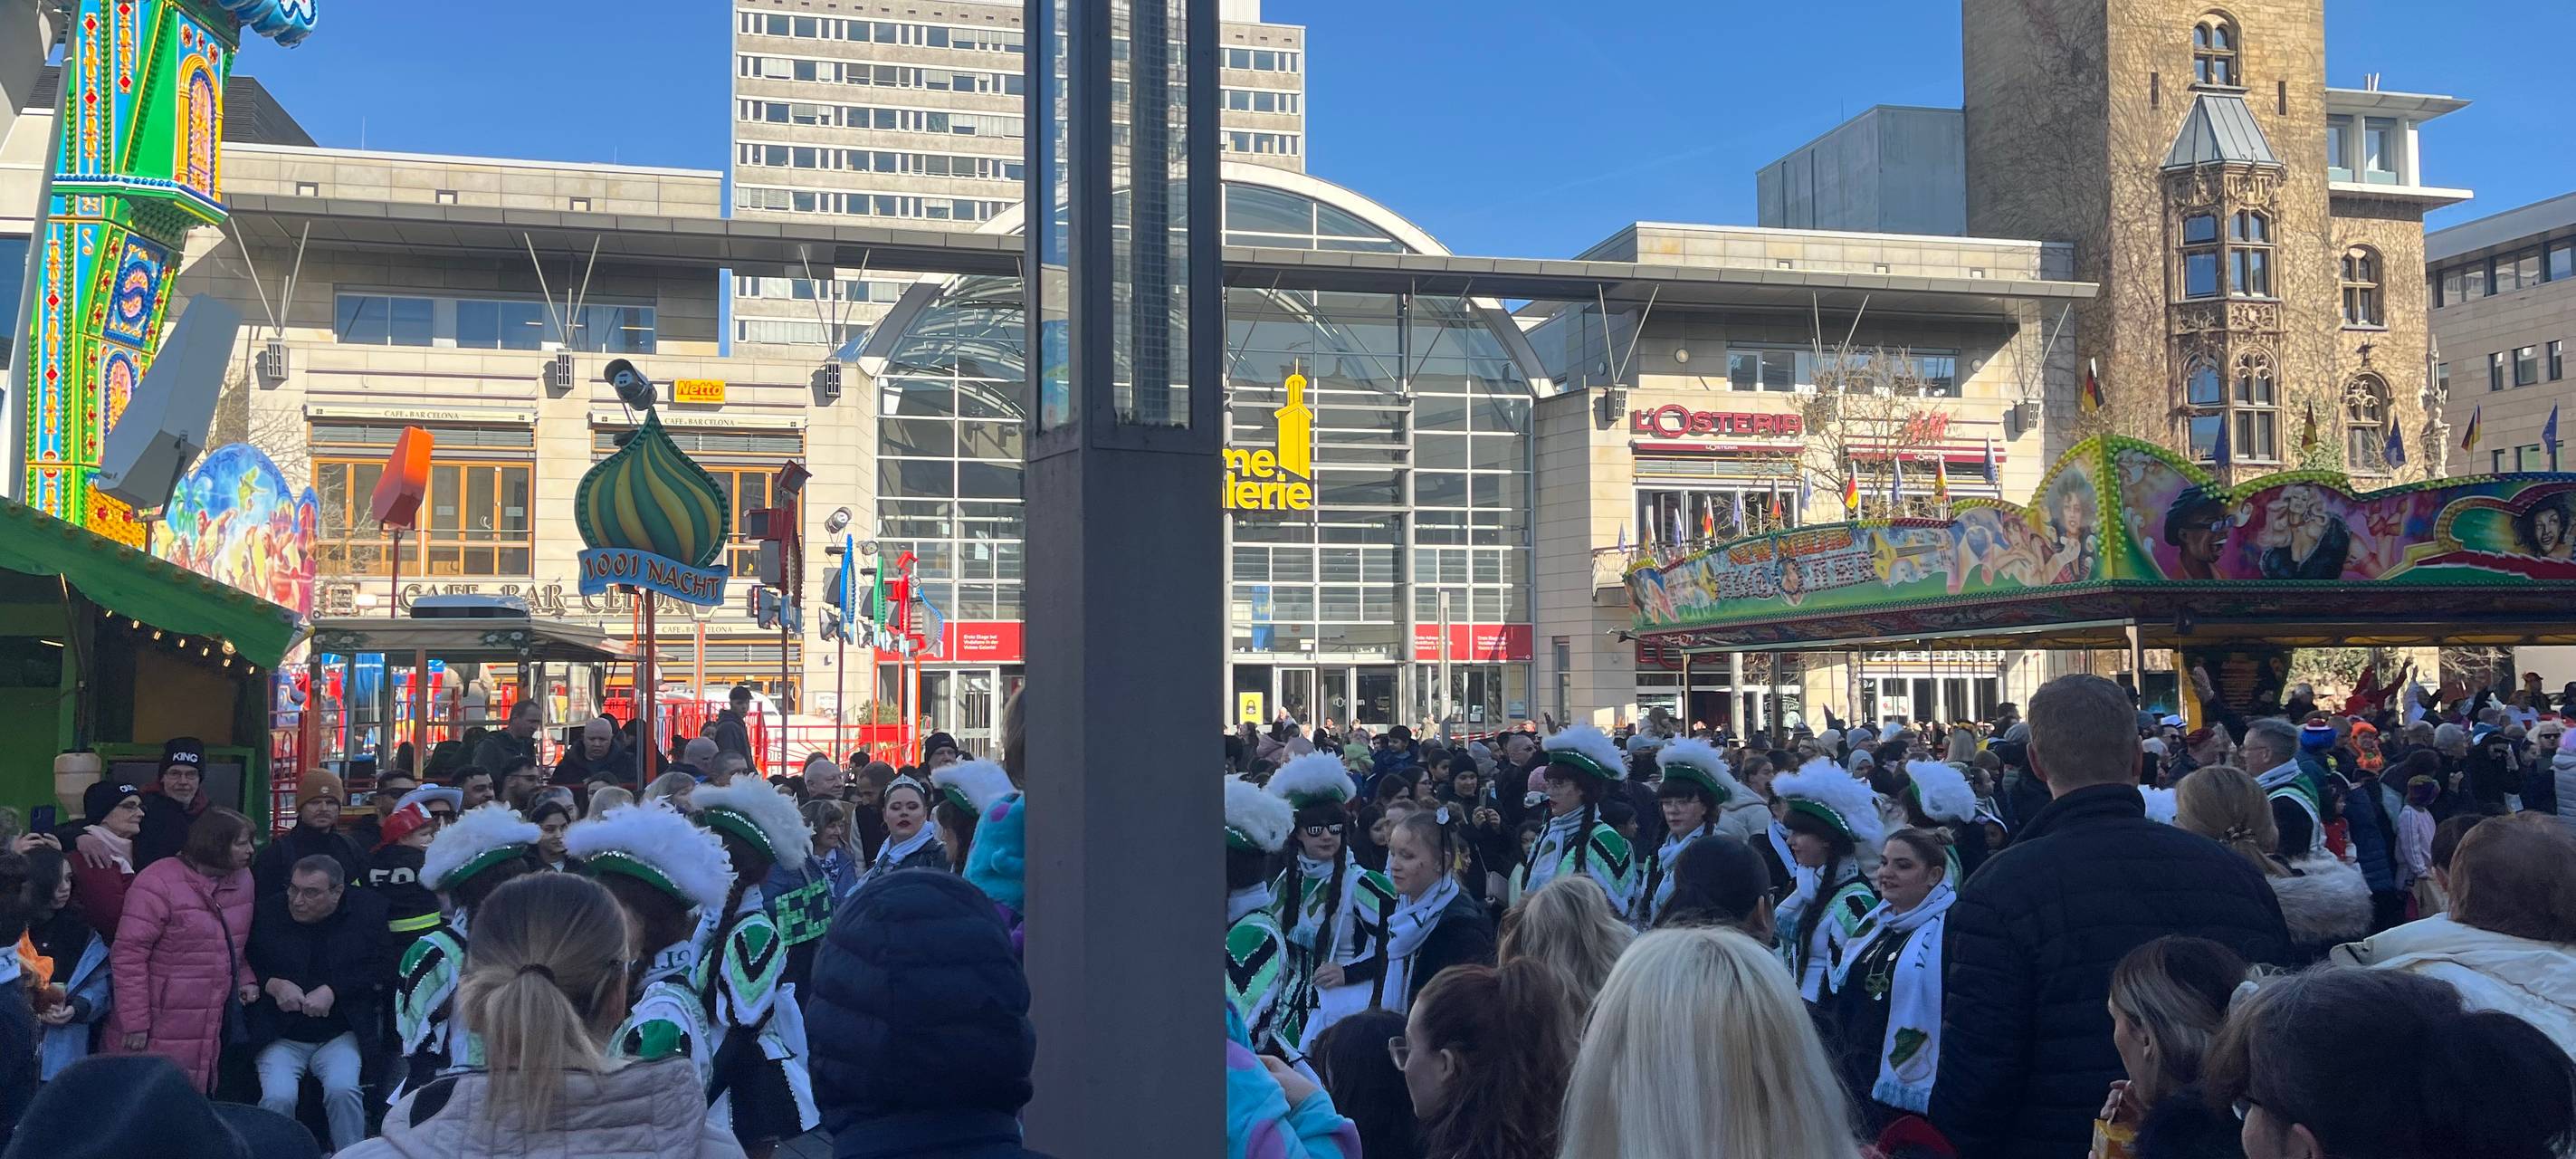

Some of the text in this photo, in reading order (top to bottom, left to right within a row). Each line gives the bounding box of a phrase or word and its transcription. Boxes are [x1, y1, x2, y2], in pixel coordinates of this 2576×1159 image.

[677, 380, 722, 395] Netto
[585, 552, 721, 599] 1001 NACHT
[173, 752, 198, 761] KING
